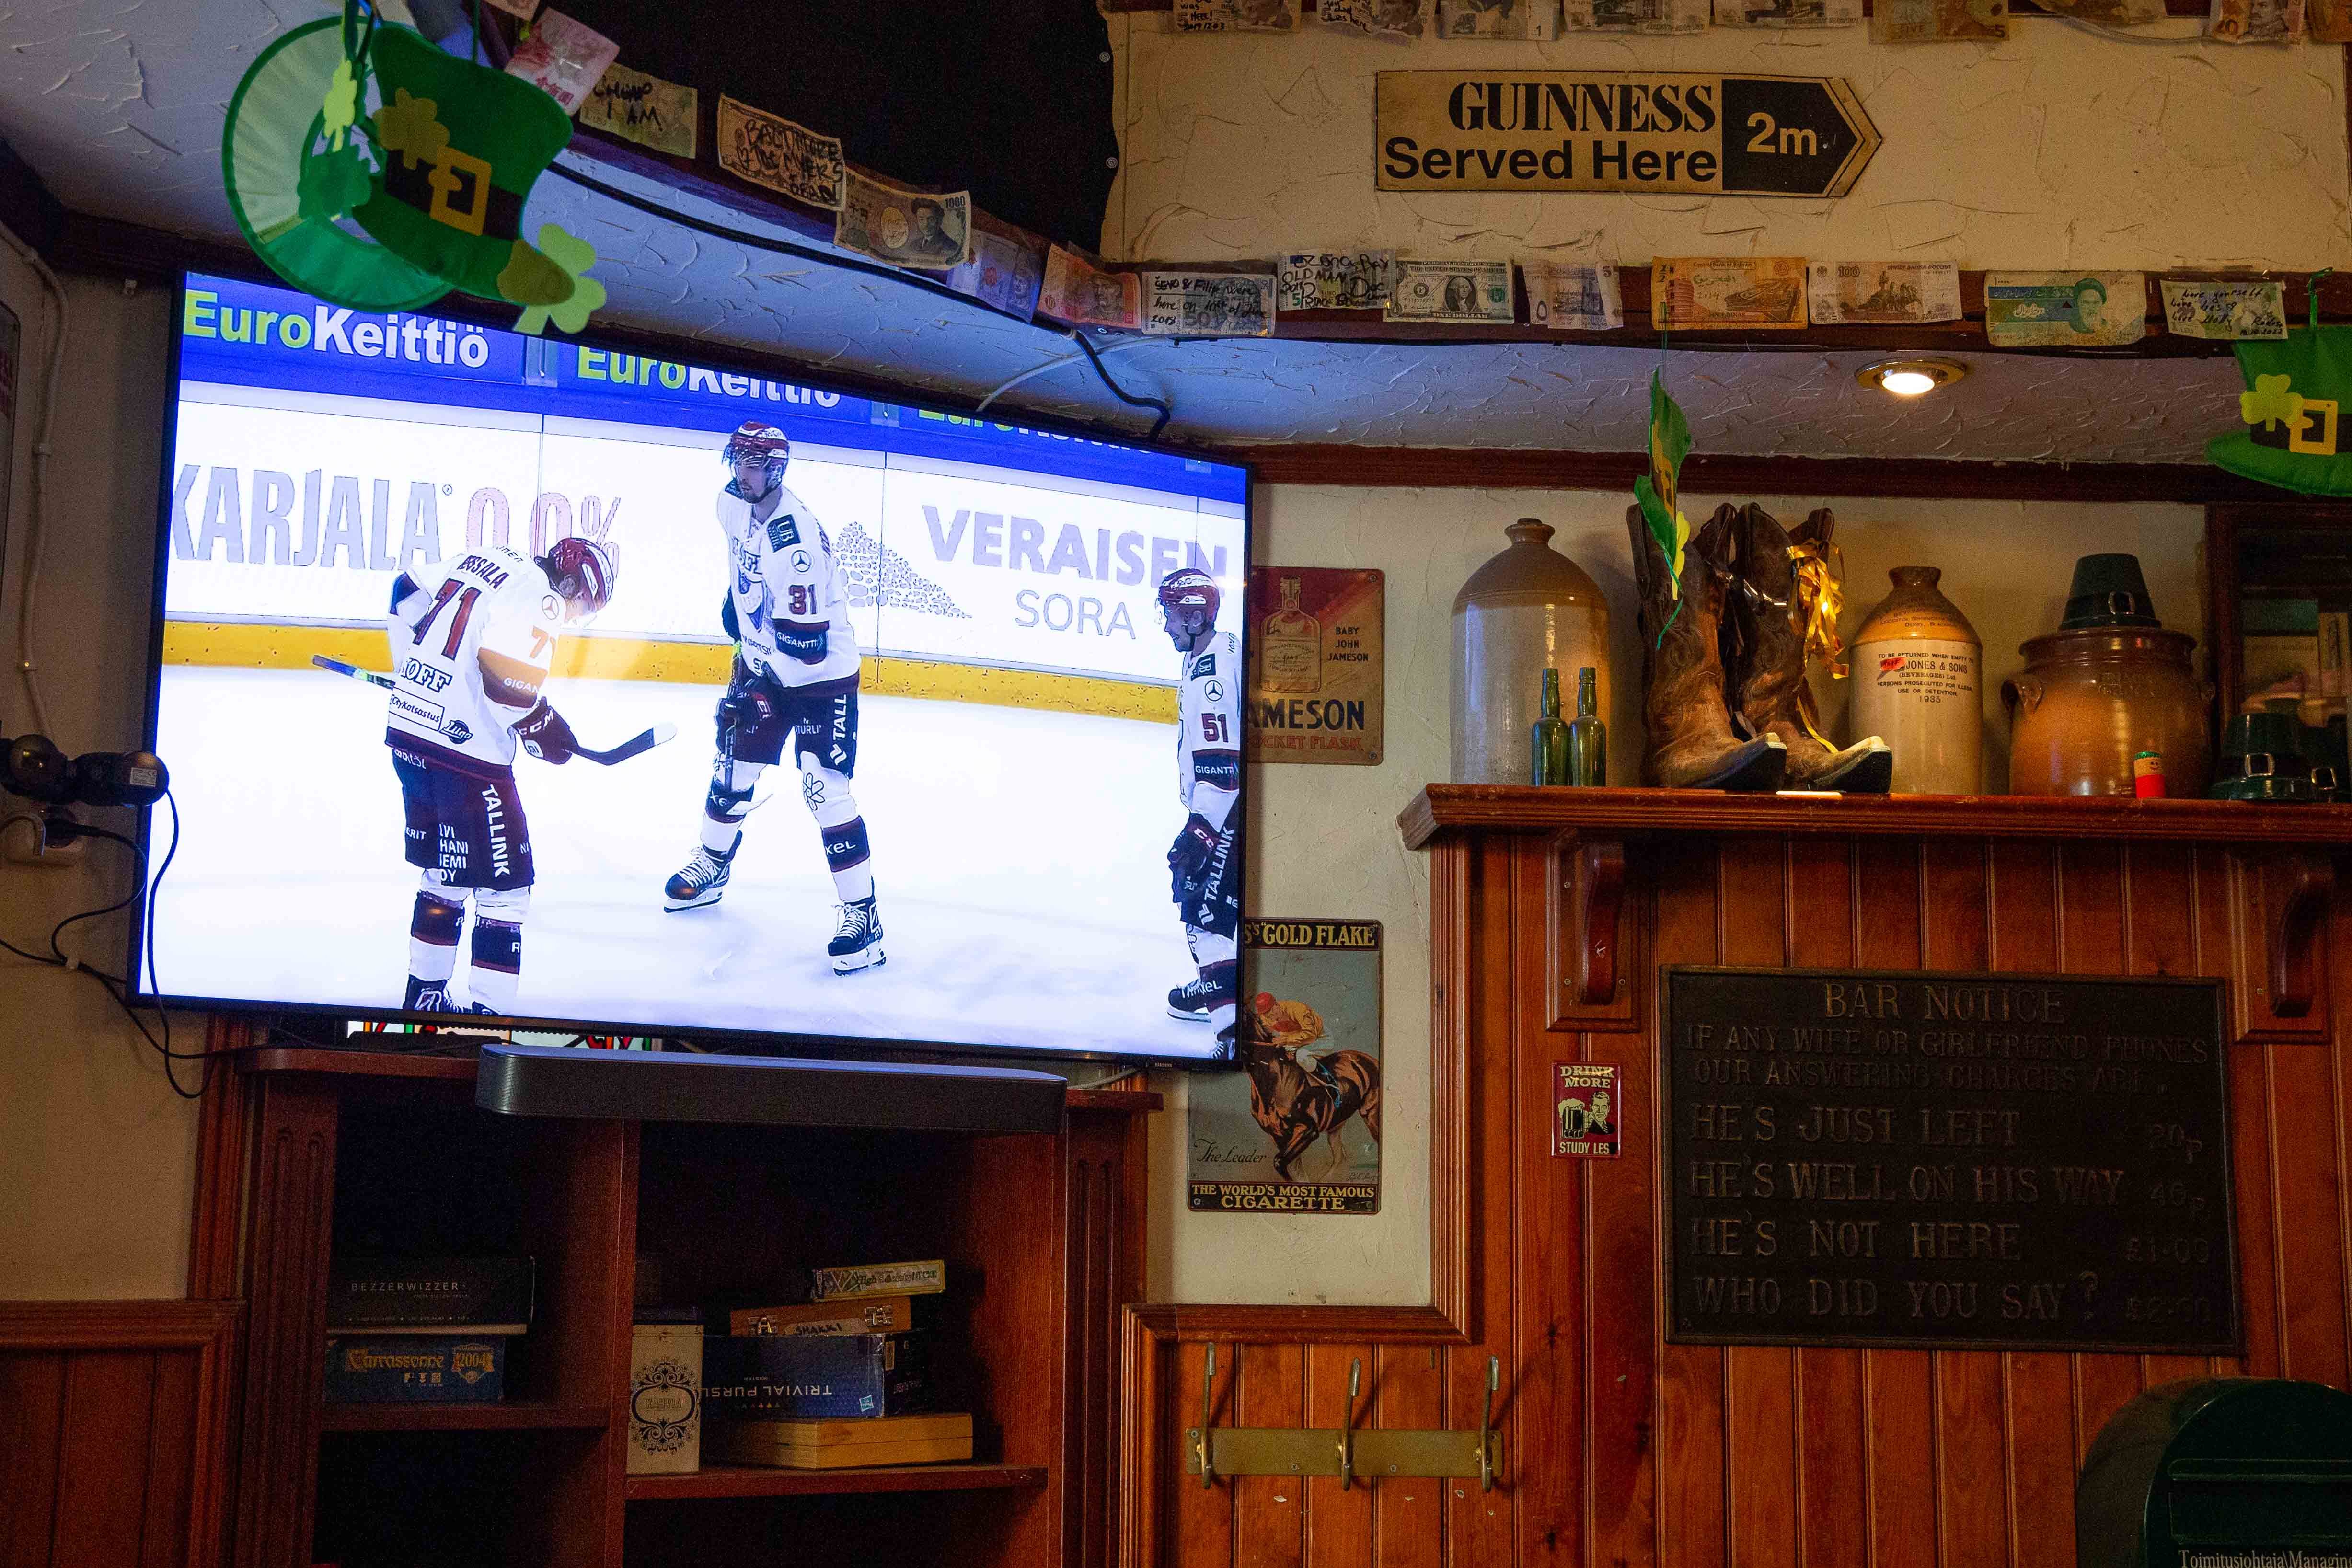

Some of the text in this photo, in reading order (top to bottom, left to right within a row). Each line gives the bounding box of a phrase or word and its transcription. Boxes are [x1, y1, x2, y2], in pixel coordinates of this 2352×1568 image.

[1448, 81, 1713, 132] GUINNESS
[1746, 112, 1818, 155] 2m
[1384, 136, 1717, 182] Served Here
[945, 196, 966, 208] 1000
[183, 289, 488, 368] EuroKeittiö
[172, 464, 442, 571] KARJALA
[922, 504, 1228, 597] VERAISEN
[788, 584, 818, 615] 31
[1015, 589, 1136, 640] SORA
[412, 577, 483, 661] 71
[1335, 627, 1359, 636] BABY
[1327, 653, 1369, 662] JAMESON
[1335, 640, 1360, 649] JOHN
[404, 657, 453, 693] OFF
[1905, 660, 1936, 670] JONES
[1939, 662, 1946, 671] &
[831, 693, 848, 741] TALL
[1201, 712, 1229, 743] 51
[1248, 698, 1365, 730] AMESON
[439, 839, 469, 855] HANI
[481, 783, 510, 878] TALLINK
[1203, 825, 1235, 901] TALLINK
[1825, 983, 2067, 1024] BAR NOTICE
[1684, 1022, 1713, 1052] IF
[1724, 1025, 1780, 1052] ANY
[1792, 1026, 1863, 1055] WIFE
[1875, 1029, 1910, 1055] OR
[1919, 1030, 2087, 1059] GIRLFRIEND
[1560, 1065, 1614, 1078] DRINK
[1564, 1077, 1611, 1089] MORE
[1694, 1057, 1752, 1085] OUR
[1764, 1059, 1930, 1089] ANSWERING
[1798, 1104, 1895, 1144] JUST
[1920, 1108, 2021, 1146] LEFT
[1194, 1138, 1267, 1164] The Leader
[1559, 1141, 1610, 1154] STUDY LES
[1191, 1185, 1375, 1198] THE WORLD'S MOST FAMOUS
[1786, 1161, 1903, 1201] WELL
[1908, 1164, 1956, 1202] ON
[1972, 1166, 2040, 1203] HIS
[2051, 1166, 2125, 1206] WAY
[1221, 1196, 1346, 1211] CIGARETTE
[1808, 1219, 1881, 1258] NOT
[1907, 1220, 2021, 1261] HERE
[352, 1282, 459, 1291] BEZZERWIZZER
[1691, 1275, 1782, 1316] WHO
[1808, 1278, 1879, 1317] DID
[1907, 1280, 1980, 1319] YOU
[1999, 1281, 2067, 1320] SAY
[762, 1385, 833, 1396] TRIVIAL
